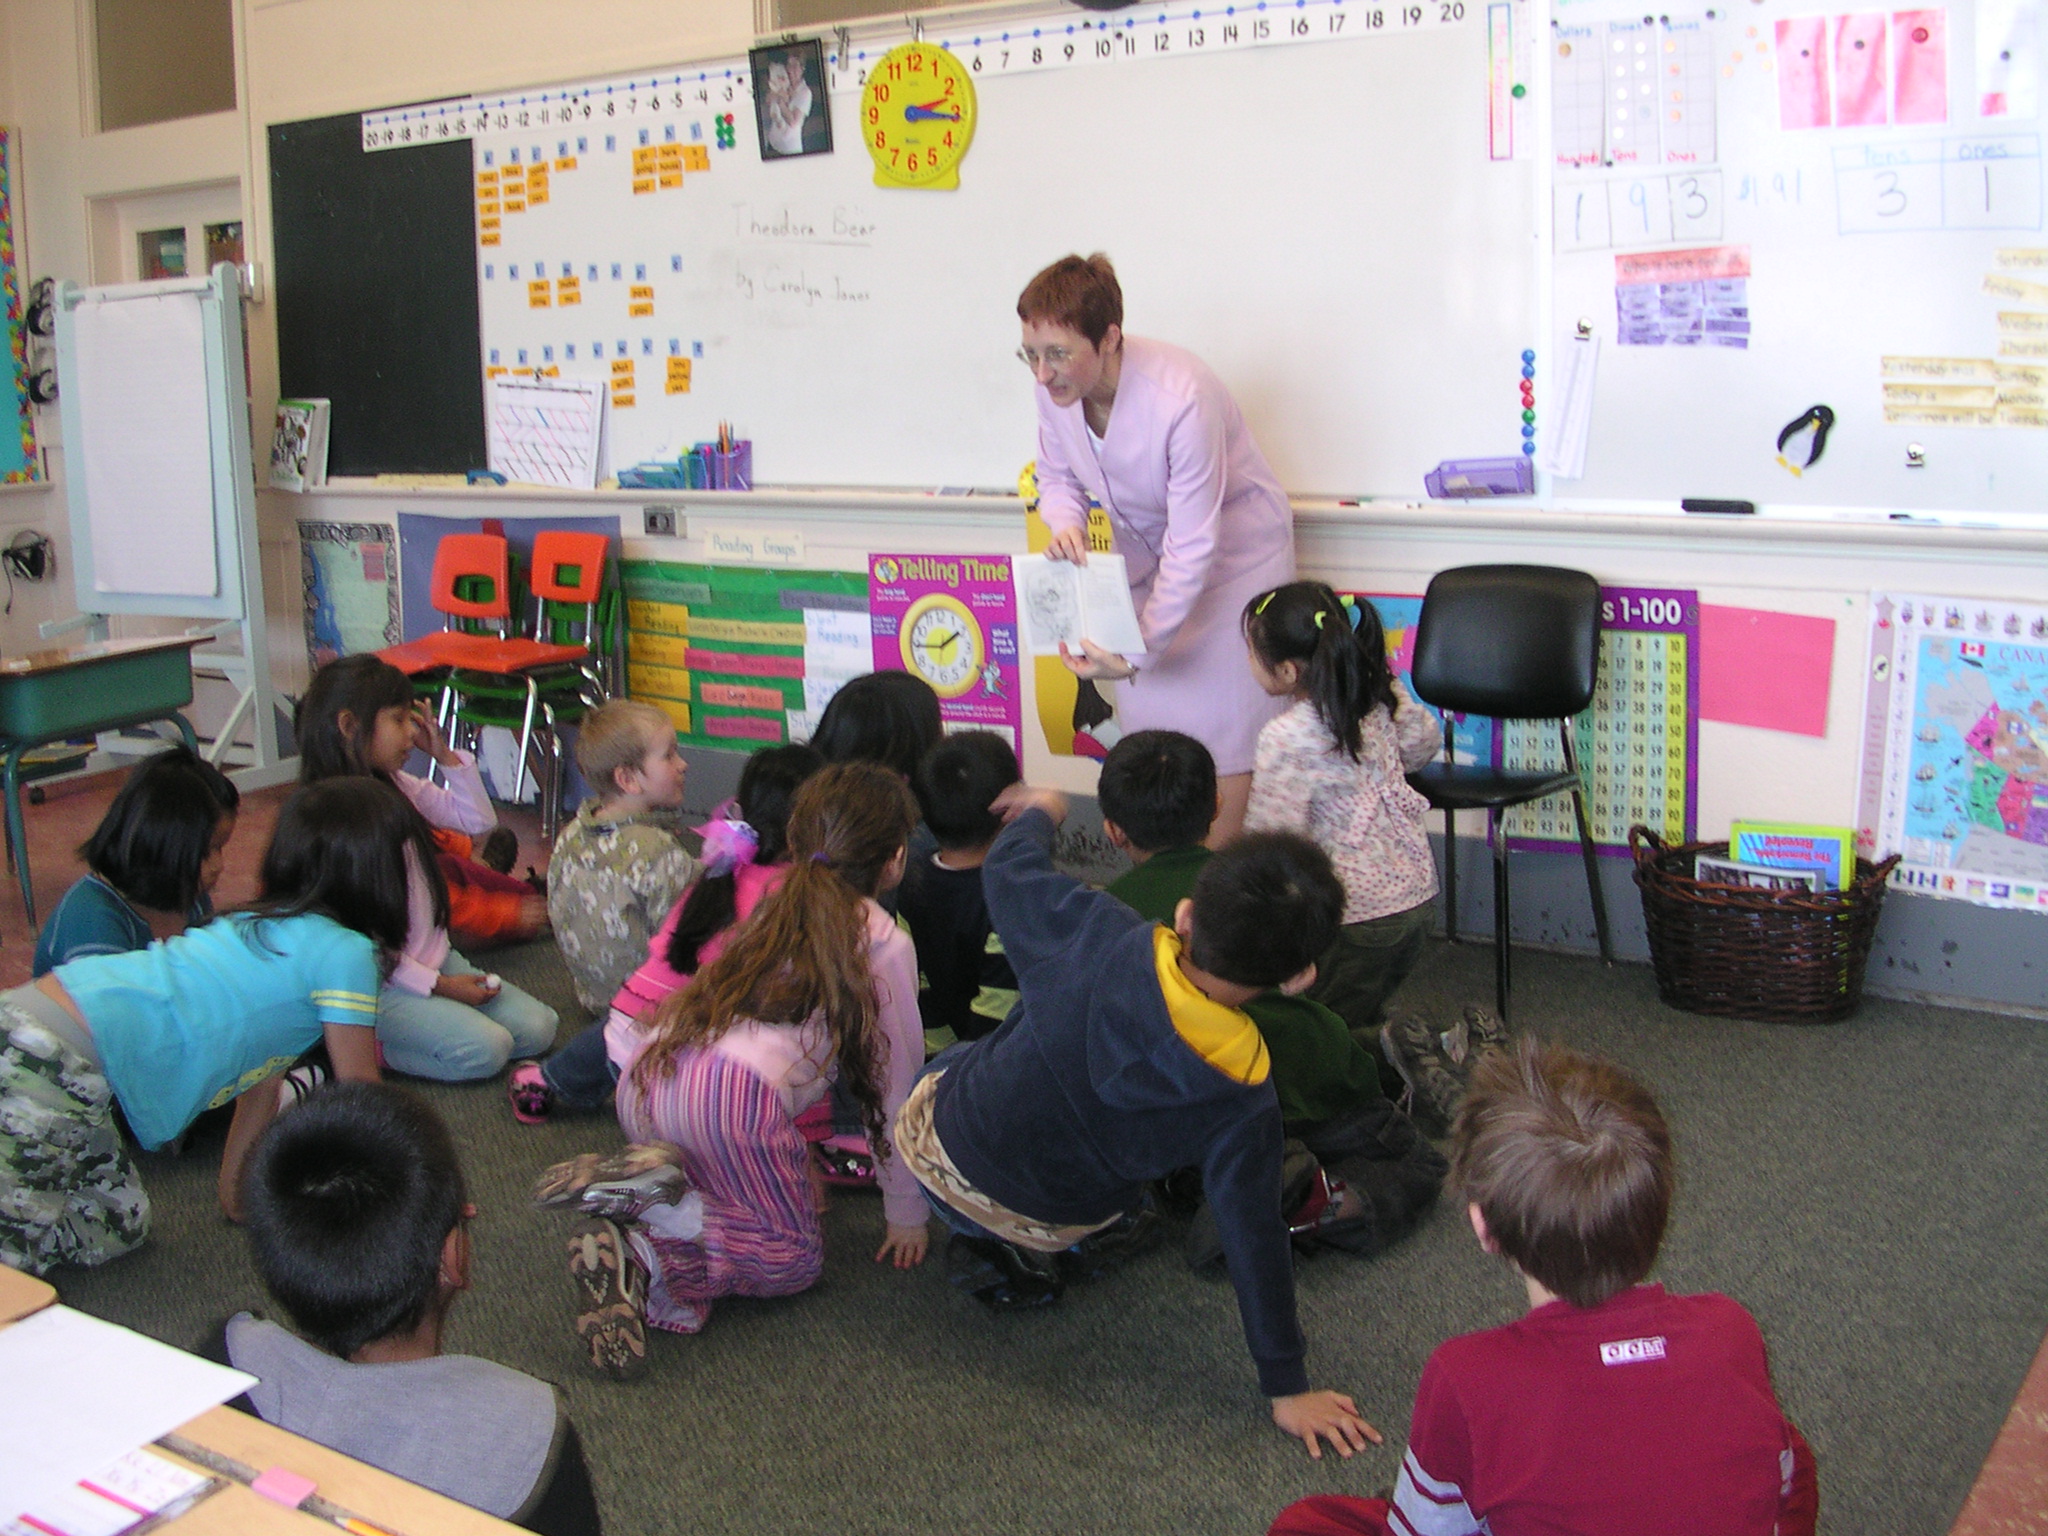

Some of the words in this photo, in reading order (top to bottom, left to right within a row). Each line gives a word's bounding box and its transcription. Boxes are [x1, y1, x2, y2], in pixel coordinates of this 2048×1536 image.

[972, 56, 982, 72] 6
[1001, 51, 1009, 68] 7
[1032, 48, 1042, 64] 8
[1064, 44, 1075, 61] 9
[1096, 39, 1111, 57] 10
[1125, 38, 1135, 55] 11
[1154, 34, 1169, 51] 12
[1188, 29, 1205, 47] 13
[1223, 25, 1238, 43] 14
[1253, 20, 1270, 40] 15
[1291, 18, 1309, 36] 16
[1329, 14, 1345, 32] 17
[1366, 10, 1384, 29] 18
[1403, 7, 1422, 26] 19
[1440, 2, 1464, 22] 20
[887, 62, 901, 81] 11
[905, 53, 923, 72] 12
[931, 58, 938, 78] 1
[873, 84, 890, 103] 10
[944, 77, 955, 96] 2
[869, 106, 879, 125] 9
[951, 104, 961, 123] 3
[875, 130, 886, 149] 8
[943, 130, 953, 149] 4
[890, 148, 900, 167] 7
[907, 153, 918, 172] 6
[927, 147, 938, 166] 5
[1667, 151, 1697, 163] Ones
[1679, 177, 1708, 219] 3
[1874, 170, 1907, 217] 3
[1984, 166, 1990, 212] 1
[1575, 192, 1583, 241] 1
[1629, 182, 1649, 233] 9
[731, 203, 816, 237] Theodora
[735, 257, 754, 300] by
[763, 263, 822, 308] Carolyn
[898, 557, 960, 589] Telling
[960, 558, 1009, 582] Time
[1619, 596, 1682, 626] 1-100
[816, 626, 859, 649] Reading
